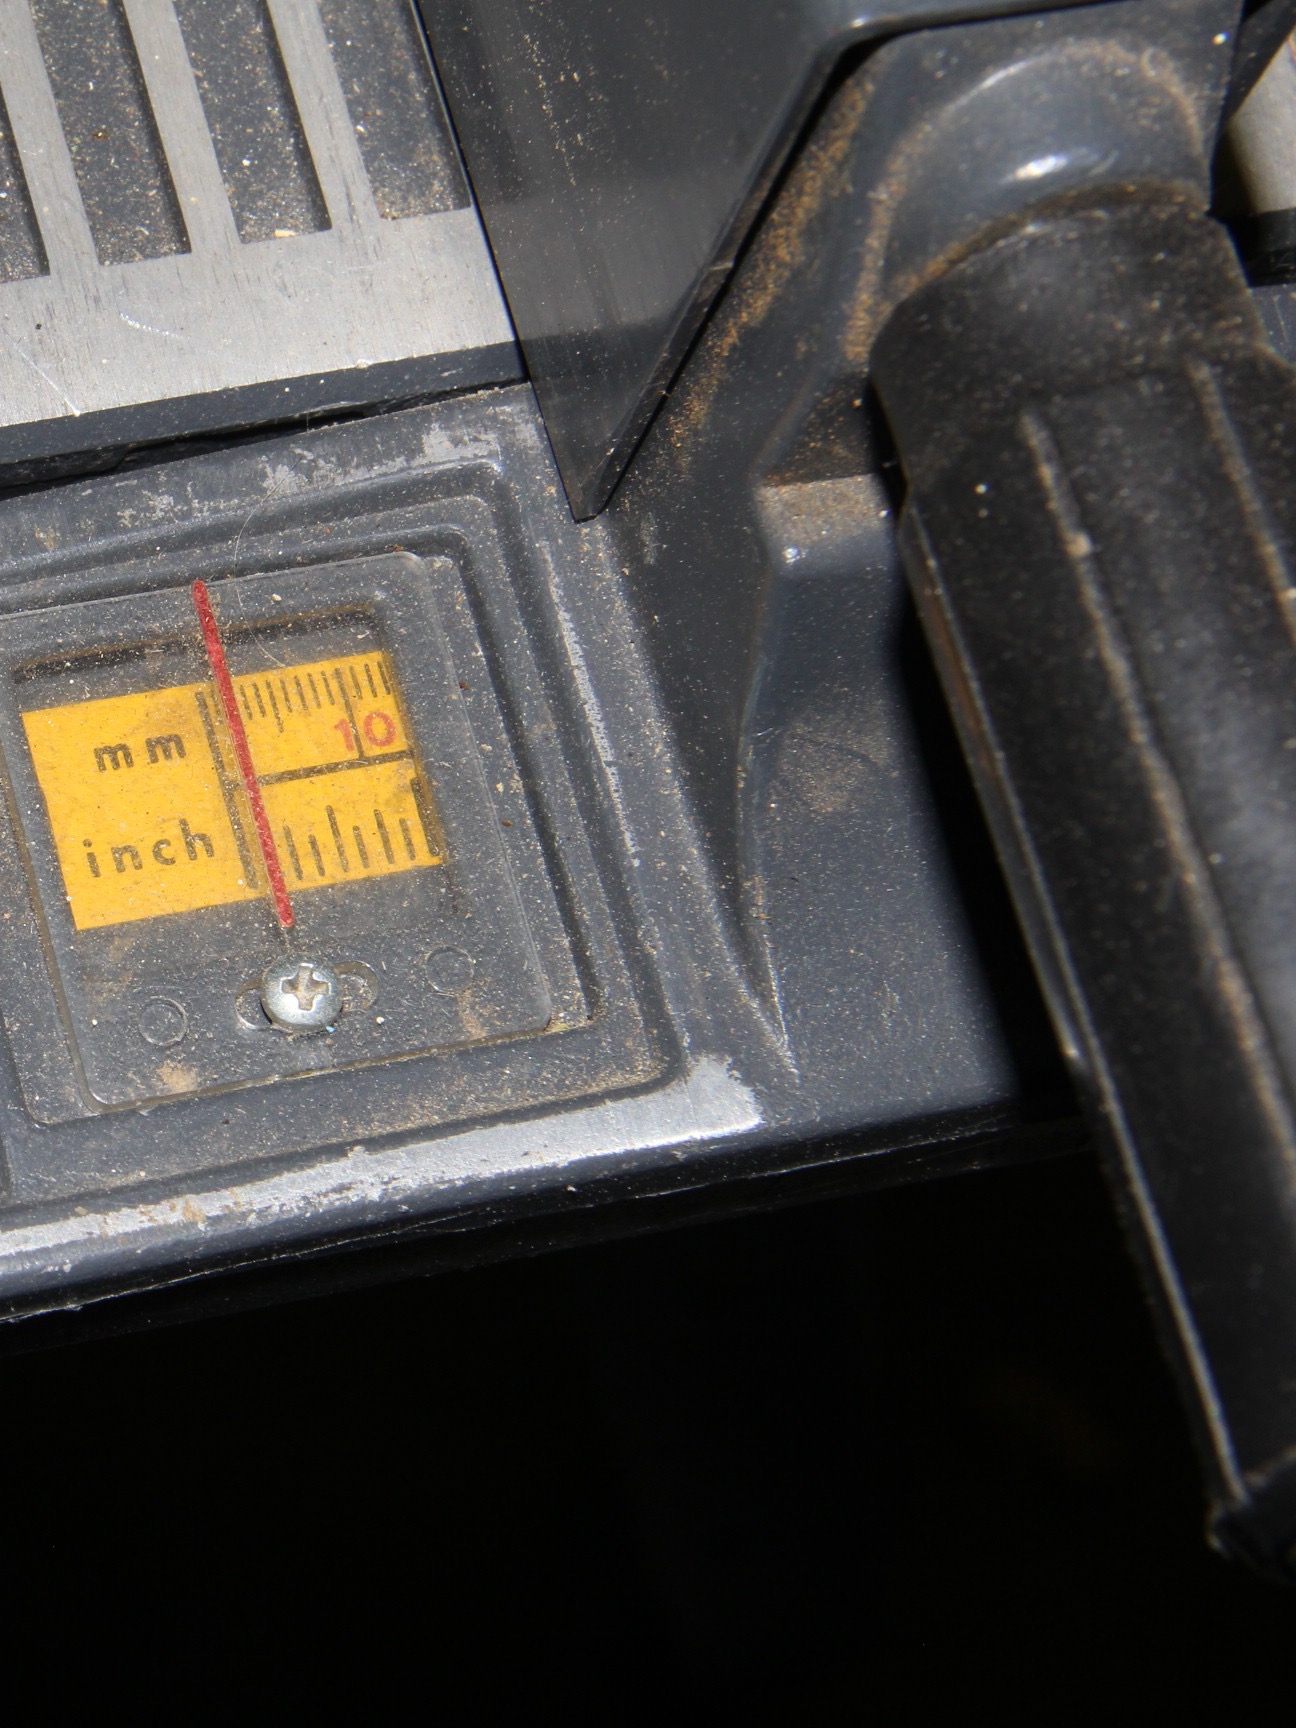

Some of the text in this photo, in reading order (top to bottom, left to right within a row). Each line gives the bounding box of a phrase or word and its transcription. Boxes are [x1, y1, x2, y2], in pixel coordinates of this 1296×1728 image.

[334, 711, 397, 751] 10
[94, 733, 187, 773] mm
[82, 818, 215, 878] inch
